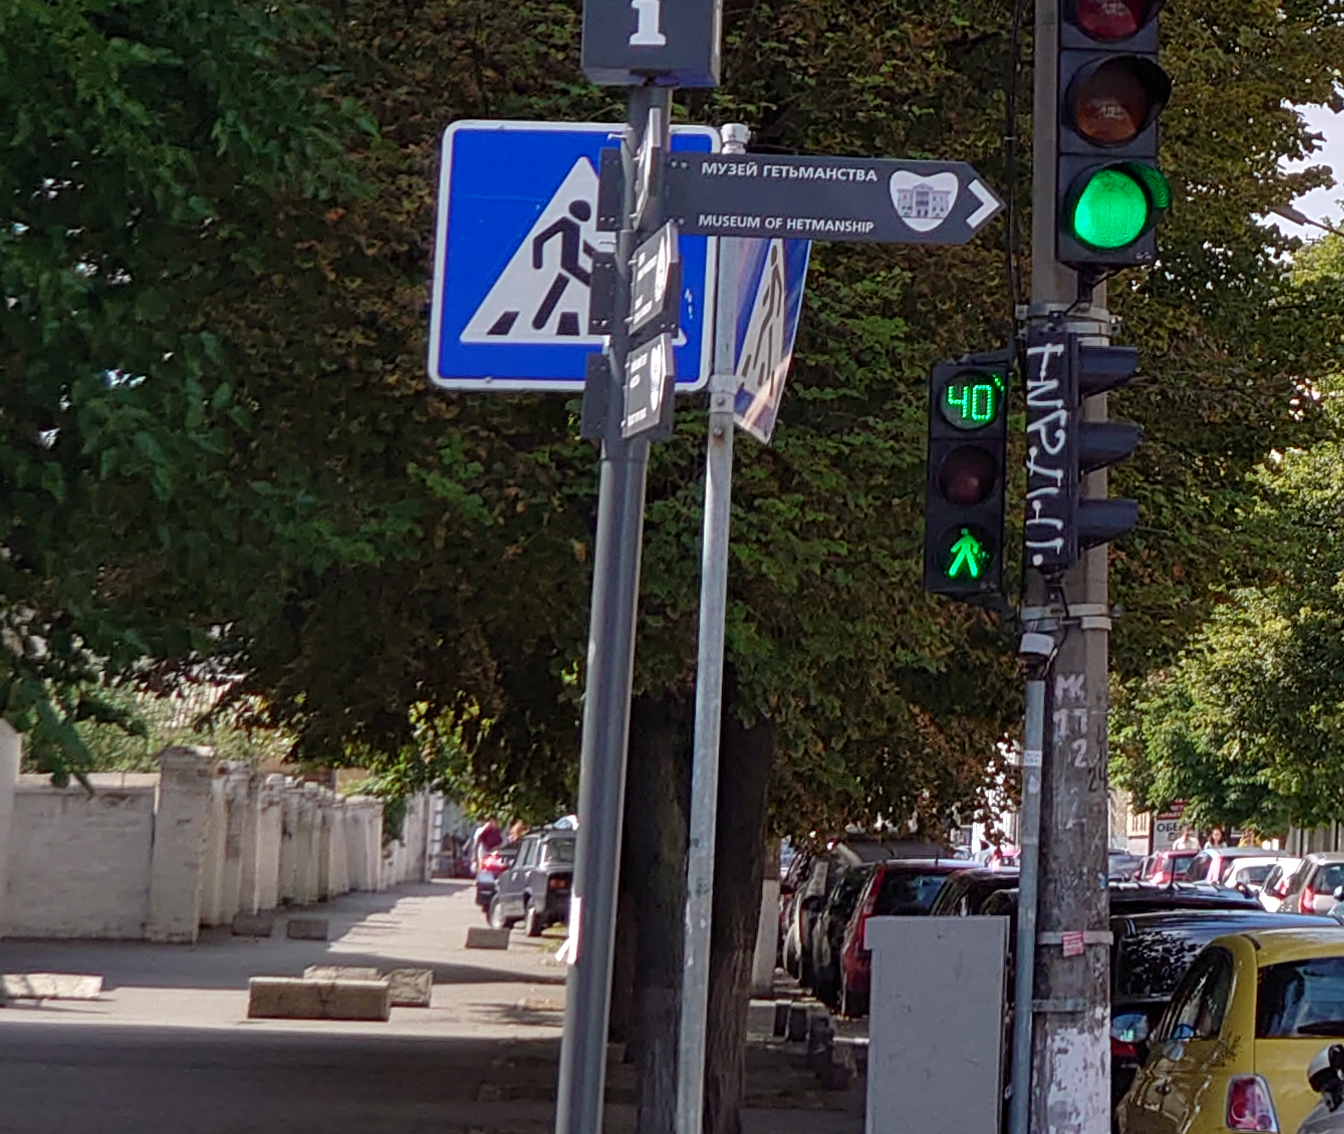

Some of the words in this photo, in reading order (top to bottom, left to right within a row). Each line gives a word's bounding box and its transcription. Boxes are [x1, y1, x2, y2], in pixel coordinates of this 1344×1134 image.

[701, 161, 758, 177] МУЗЕЙ
[763, 165, 878, 182] ГЕТЬМАНСТВА
[698, 215, 760, 229] MUSEUM
[764, 217, 783, 230] OF
[786, 218, 874, 233] HETMANSHIP
[948, 385, 993, 421] 40
